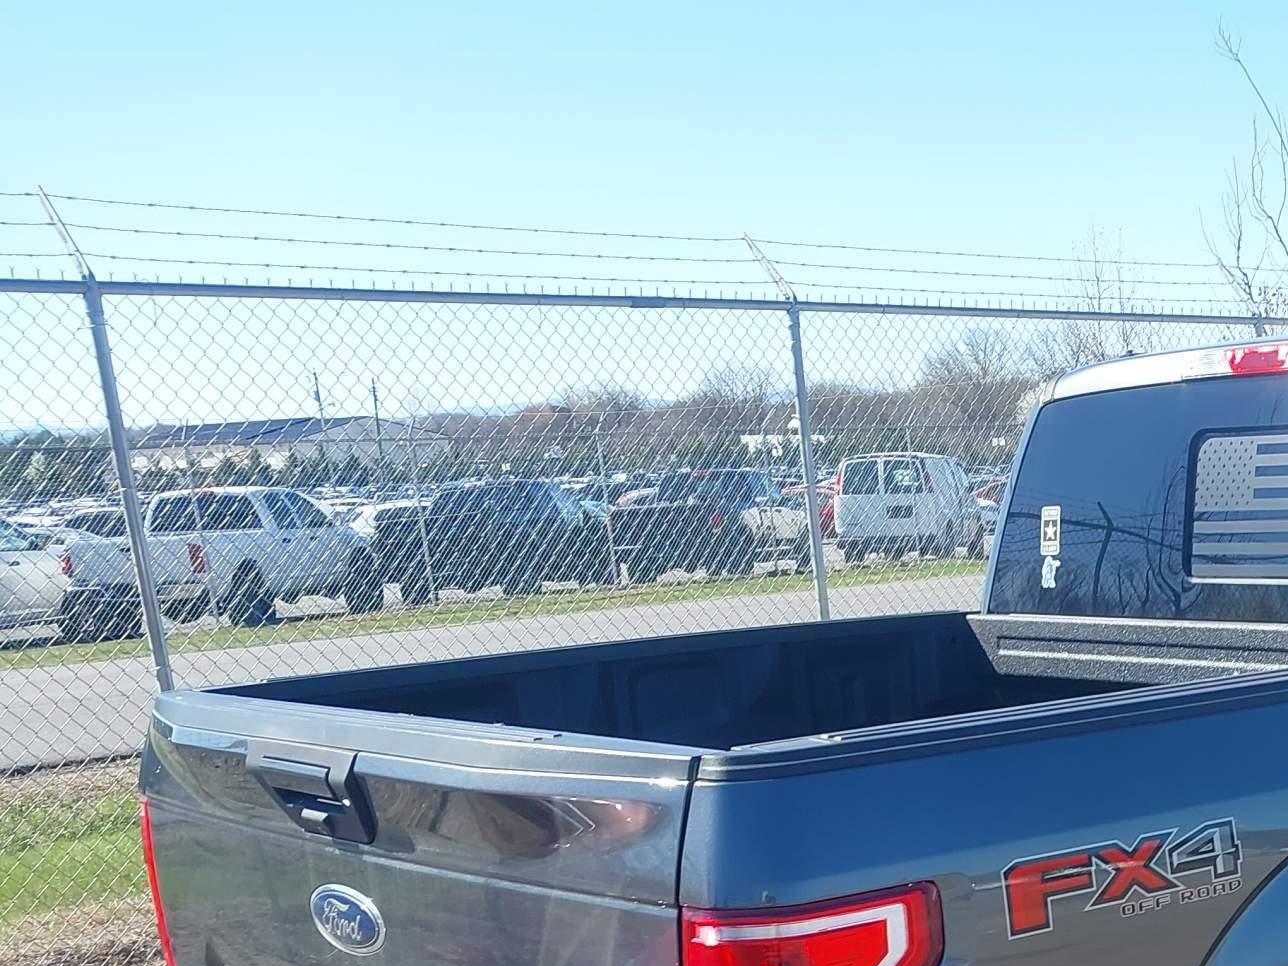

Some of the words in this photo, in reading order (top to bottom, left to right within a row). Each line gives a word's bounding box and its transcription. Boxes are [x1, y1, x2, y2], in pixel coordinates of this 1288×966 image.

[1001, 816, 1243, 940] FX4
[1121, 893, 1172, 918] OFF
[1178, 878, 1243, 905] ROAD
[321, 898, 363, 941] Ford
